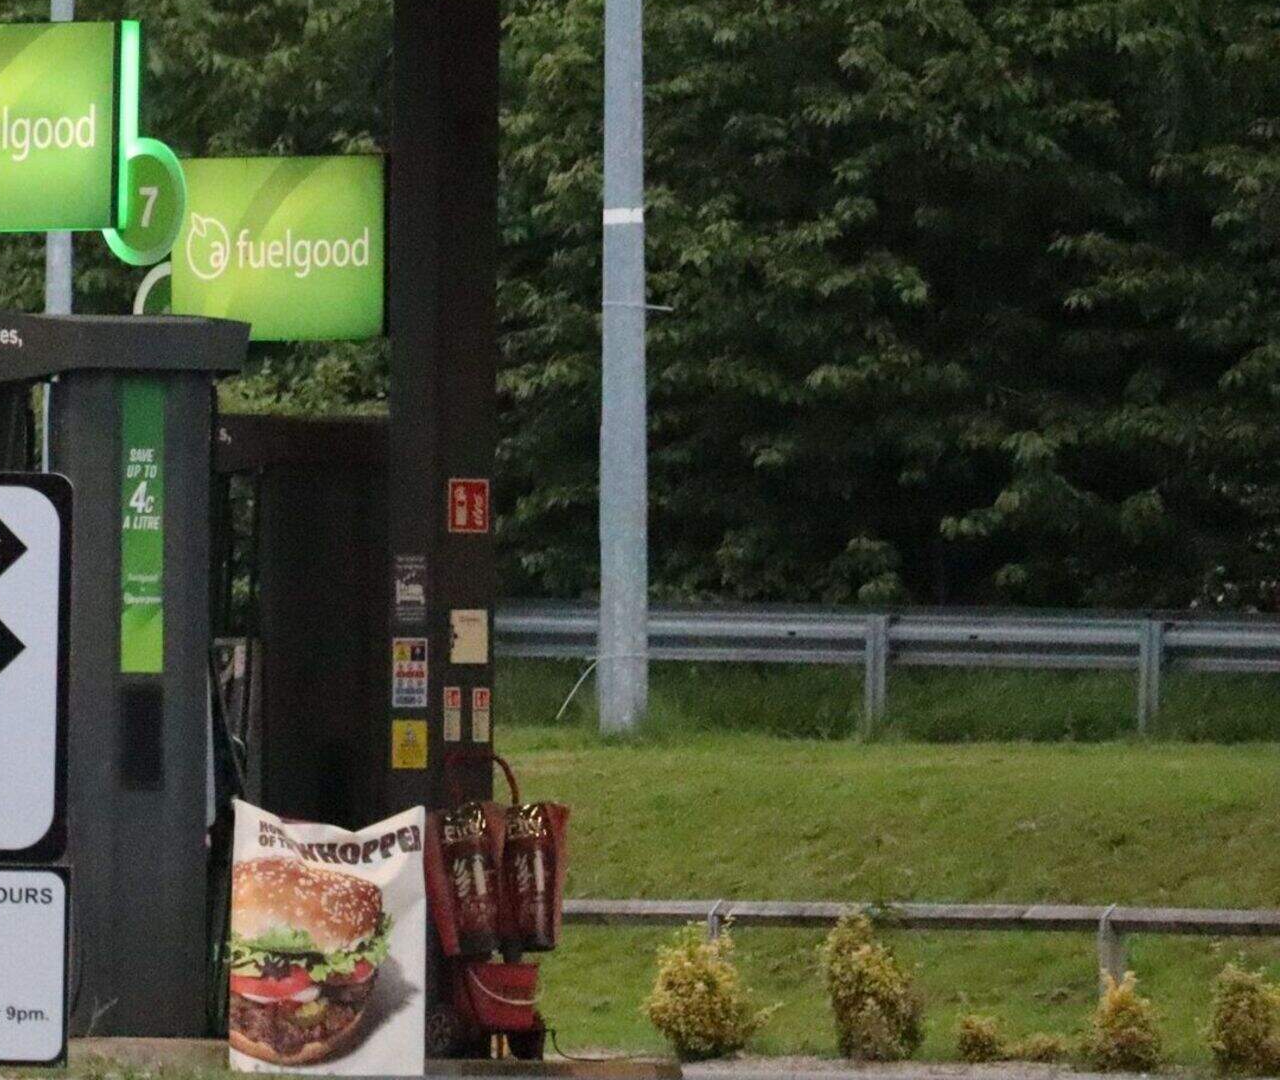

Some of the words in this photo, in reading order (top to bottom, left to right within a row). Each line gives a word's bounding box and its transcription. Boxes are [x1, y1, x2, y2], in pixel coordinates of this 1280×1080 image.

[139, 186, 158, 228] 7
[236, 227, 370, 279] fuelgood
[129, 448, 155, 463] SAVE
[126, 464, 141, 479] UP
[144, 464, 158, 479] TO
[122, 516, 131, 530] A
[132, 516, 161, 531] LITRE
[5, 1005, 50, 1024] 9pm.
